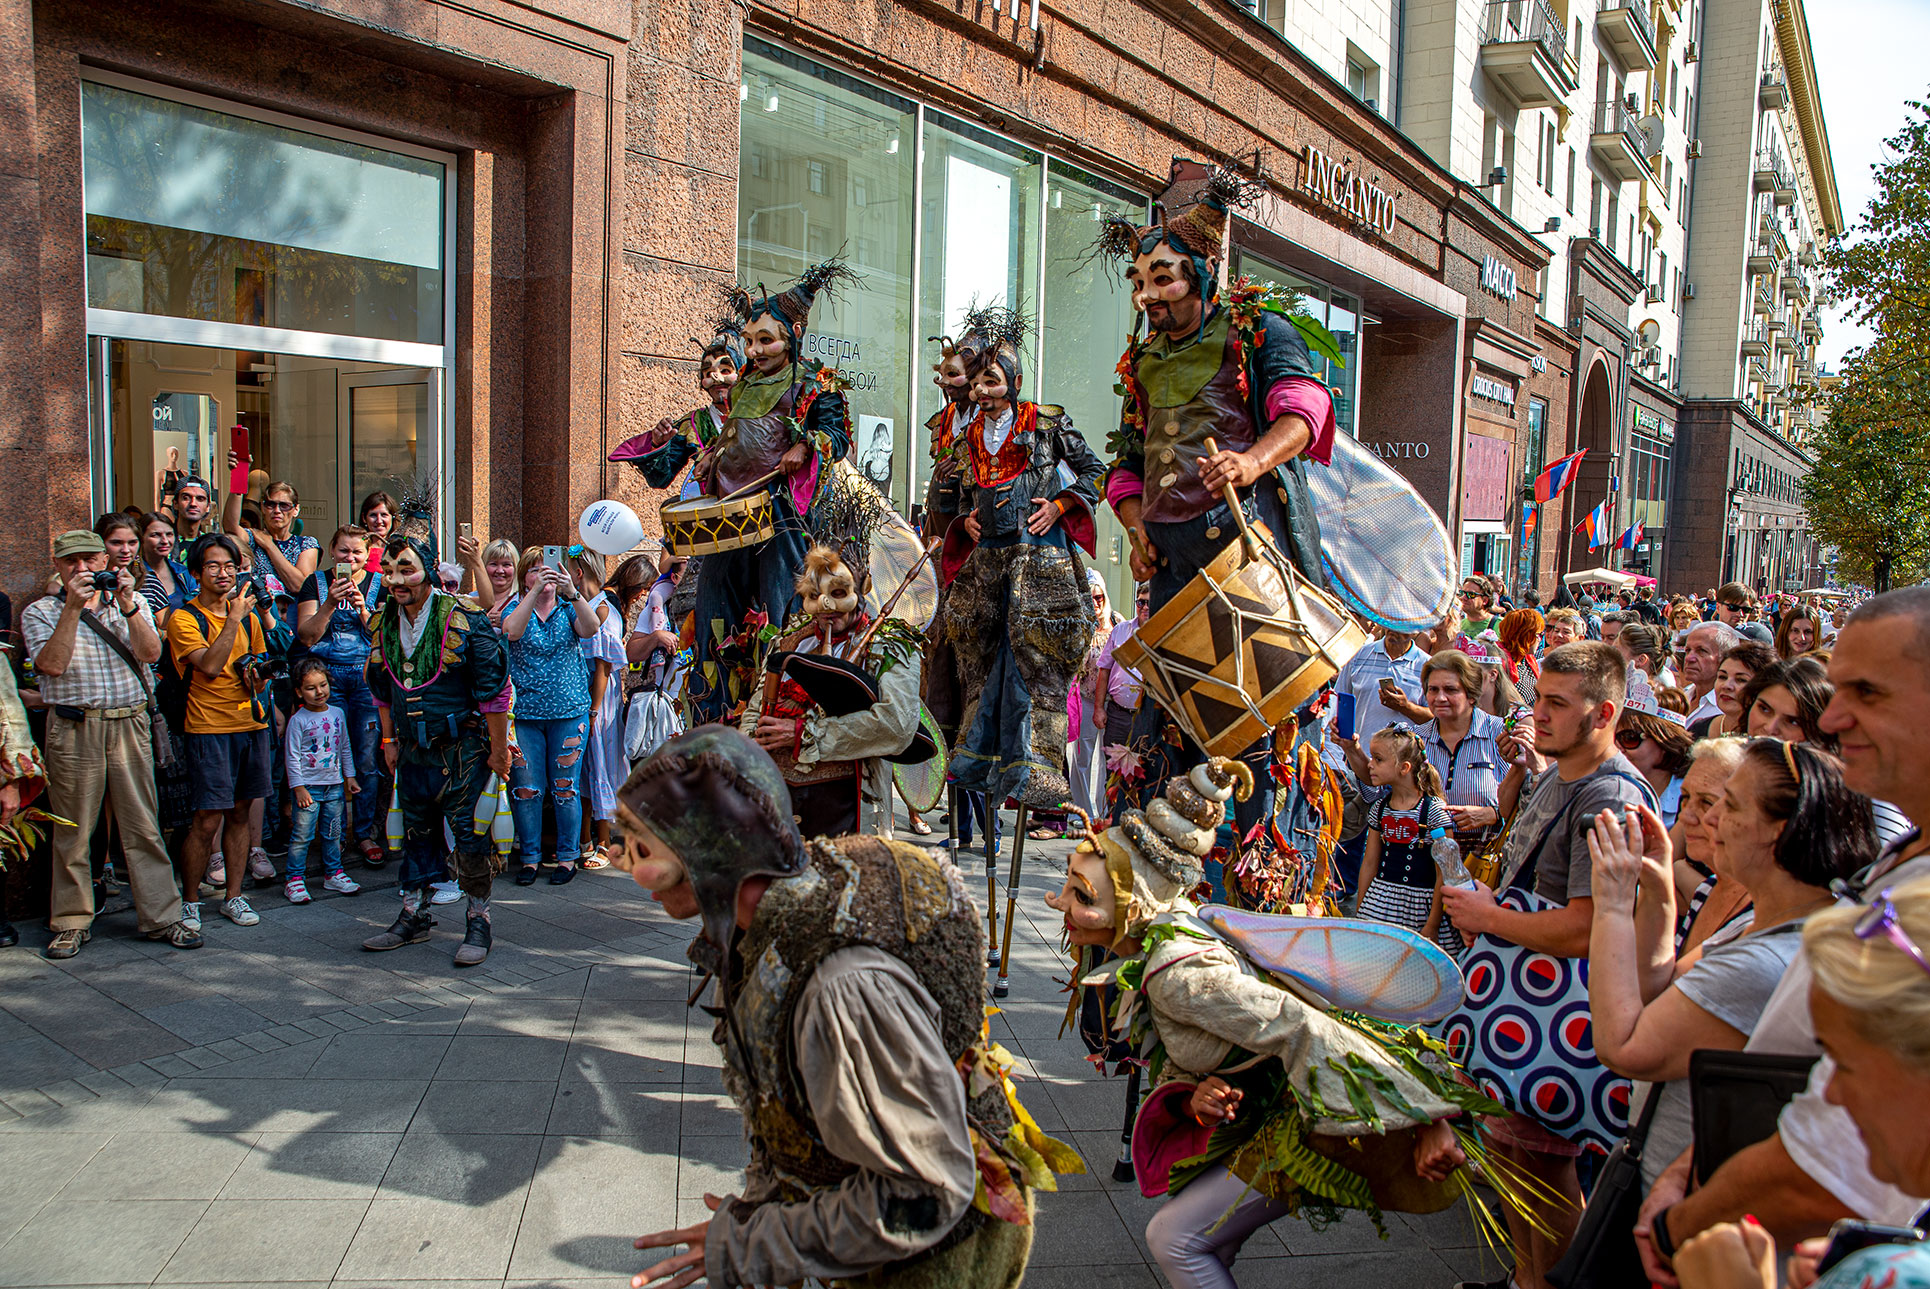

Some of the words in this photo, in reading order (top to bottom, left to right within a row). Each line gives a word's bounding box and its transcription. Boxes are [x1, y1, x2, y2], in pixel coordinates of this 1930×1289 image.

[1304, 144, 1396, 234] INCANTO
[1483, 254, 1518, 302] КАССА
[809, 333, 861, 363] ВСЕГДА
[1364, 442, 1430, 459] ANTO
